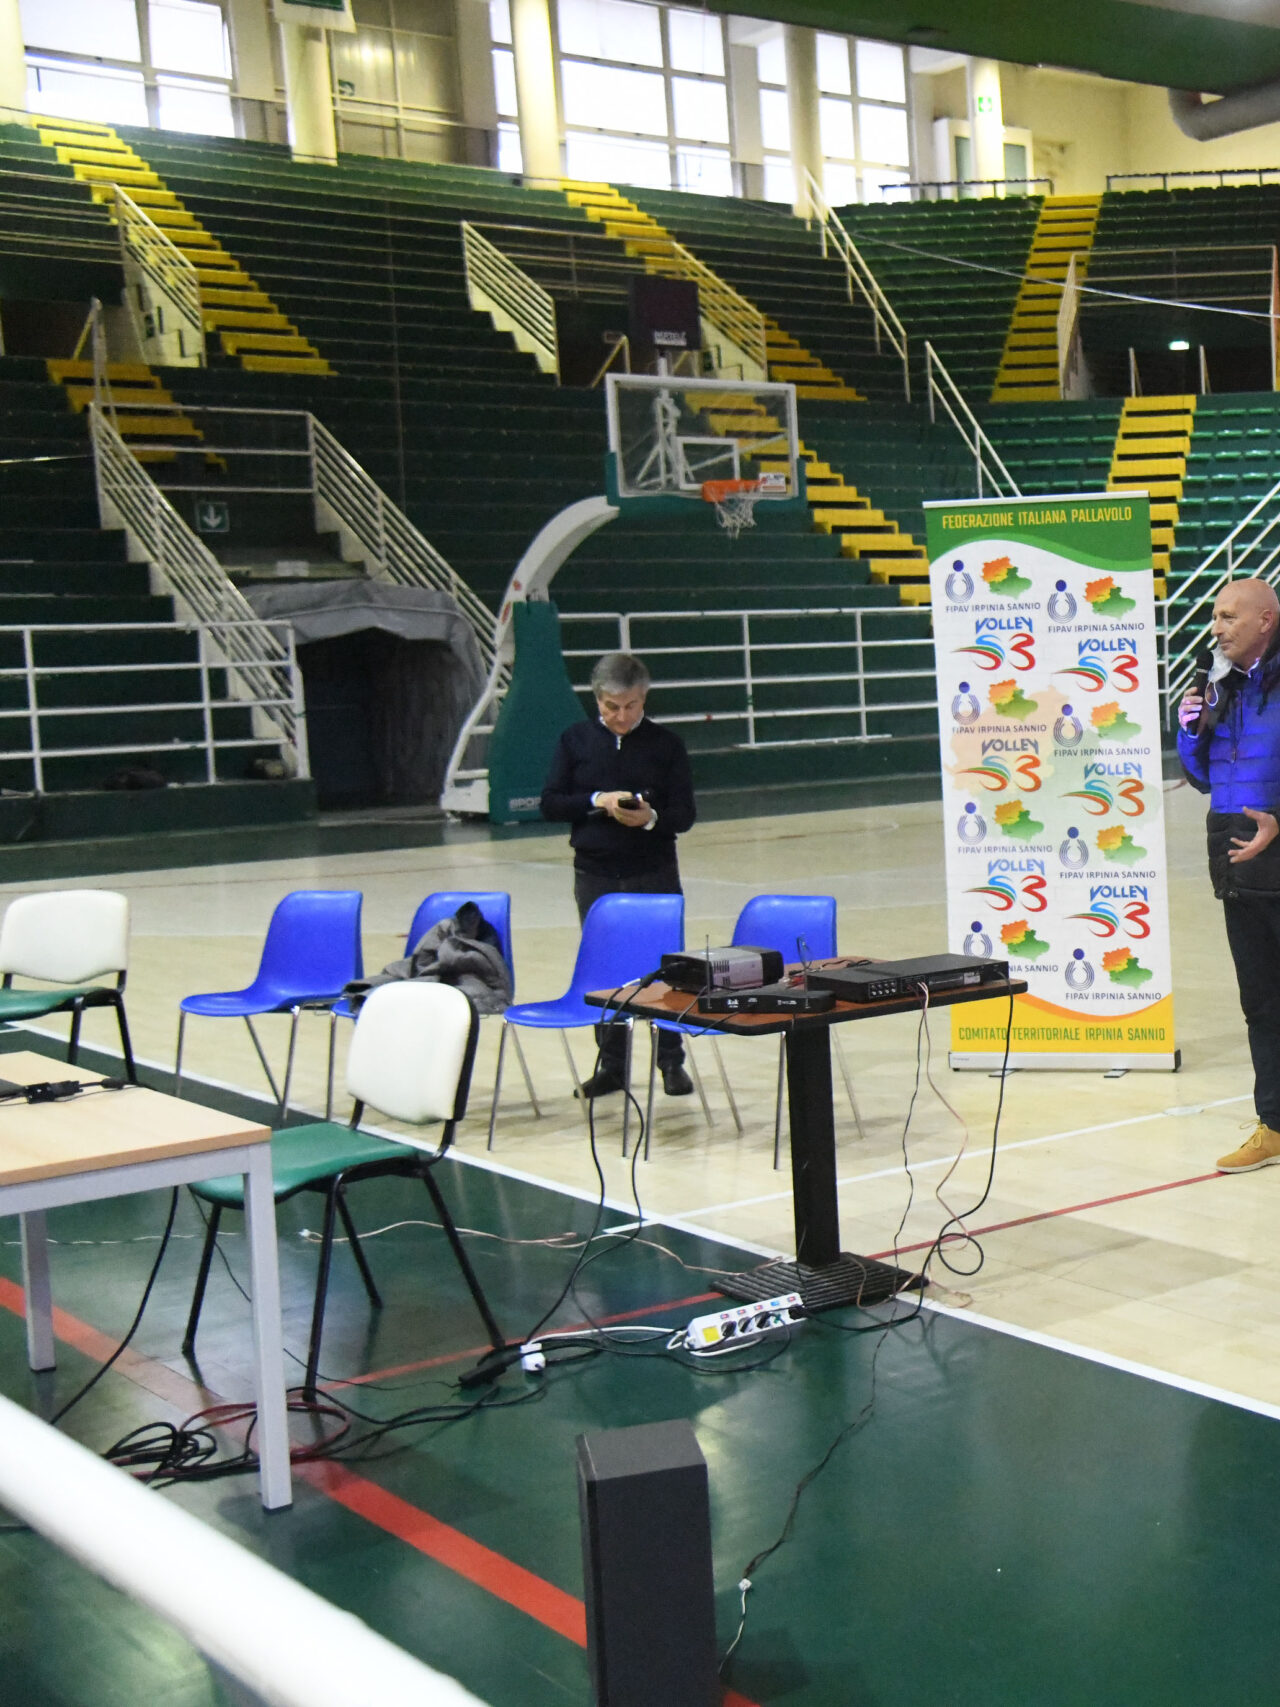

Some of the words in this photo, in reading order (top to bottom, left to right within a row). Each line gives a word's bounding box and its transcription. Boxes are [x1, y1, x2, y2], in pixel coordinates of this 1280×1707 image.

[942, 512, 1014, 529] FEDERAZIONE
[1018, 510, 1066, 526] ITALIANA
[1072, 506, 1132, 523] PALLAVOLO
[946, 605, 969, 613] FIPAV
[972, 604, 1004, 612] IRPINIA
[1007, 602, 1041, 610] SANNIO
[976, 616, 1033, 634] VOLLEY
[1048, 625, 1073, 633] FIPAV
[1074, 624, 1108, 632] IRPINIA
[1110, 623, 1145, 631] SANNIO
[1078, 638, 1136, 656] VOLLEY
[982, 738, 1039, 755] VOLLEY
[1054, 748, 1078, 757] FIPAV
[1080, 748, 1113, 756] IRPINIA
[1116, 747, 1150, 755] SANNIO
[1084, 762, 1142, 780] VOLLEY
[958, 846, 981, 854] FIPAV
[984, 845, 1017, 854] IRPINIA
[988, 858, 1045, 876] VOLLEY
[1122, 870, 1156, 878] SANNIO
[1090, 885, 1148, 902] VOLLEY
[1024, 964, 1059, 972] SANNIO
[1128, 992, 1162, 1000] SANNIO
[958, 1028, 1007, 1040] COMITATO
[1012, 1028, 1080, 1040] TERRITORIALE
[1086, 1028, 1123, 1040] IRPINIA
[1128, 1028, 1165, 1041] SANNIO
